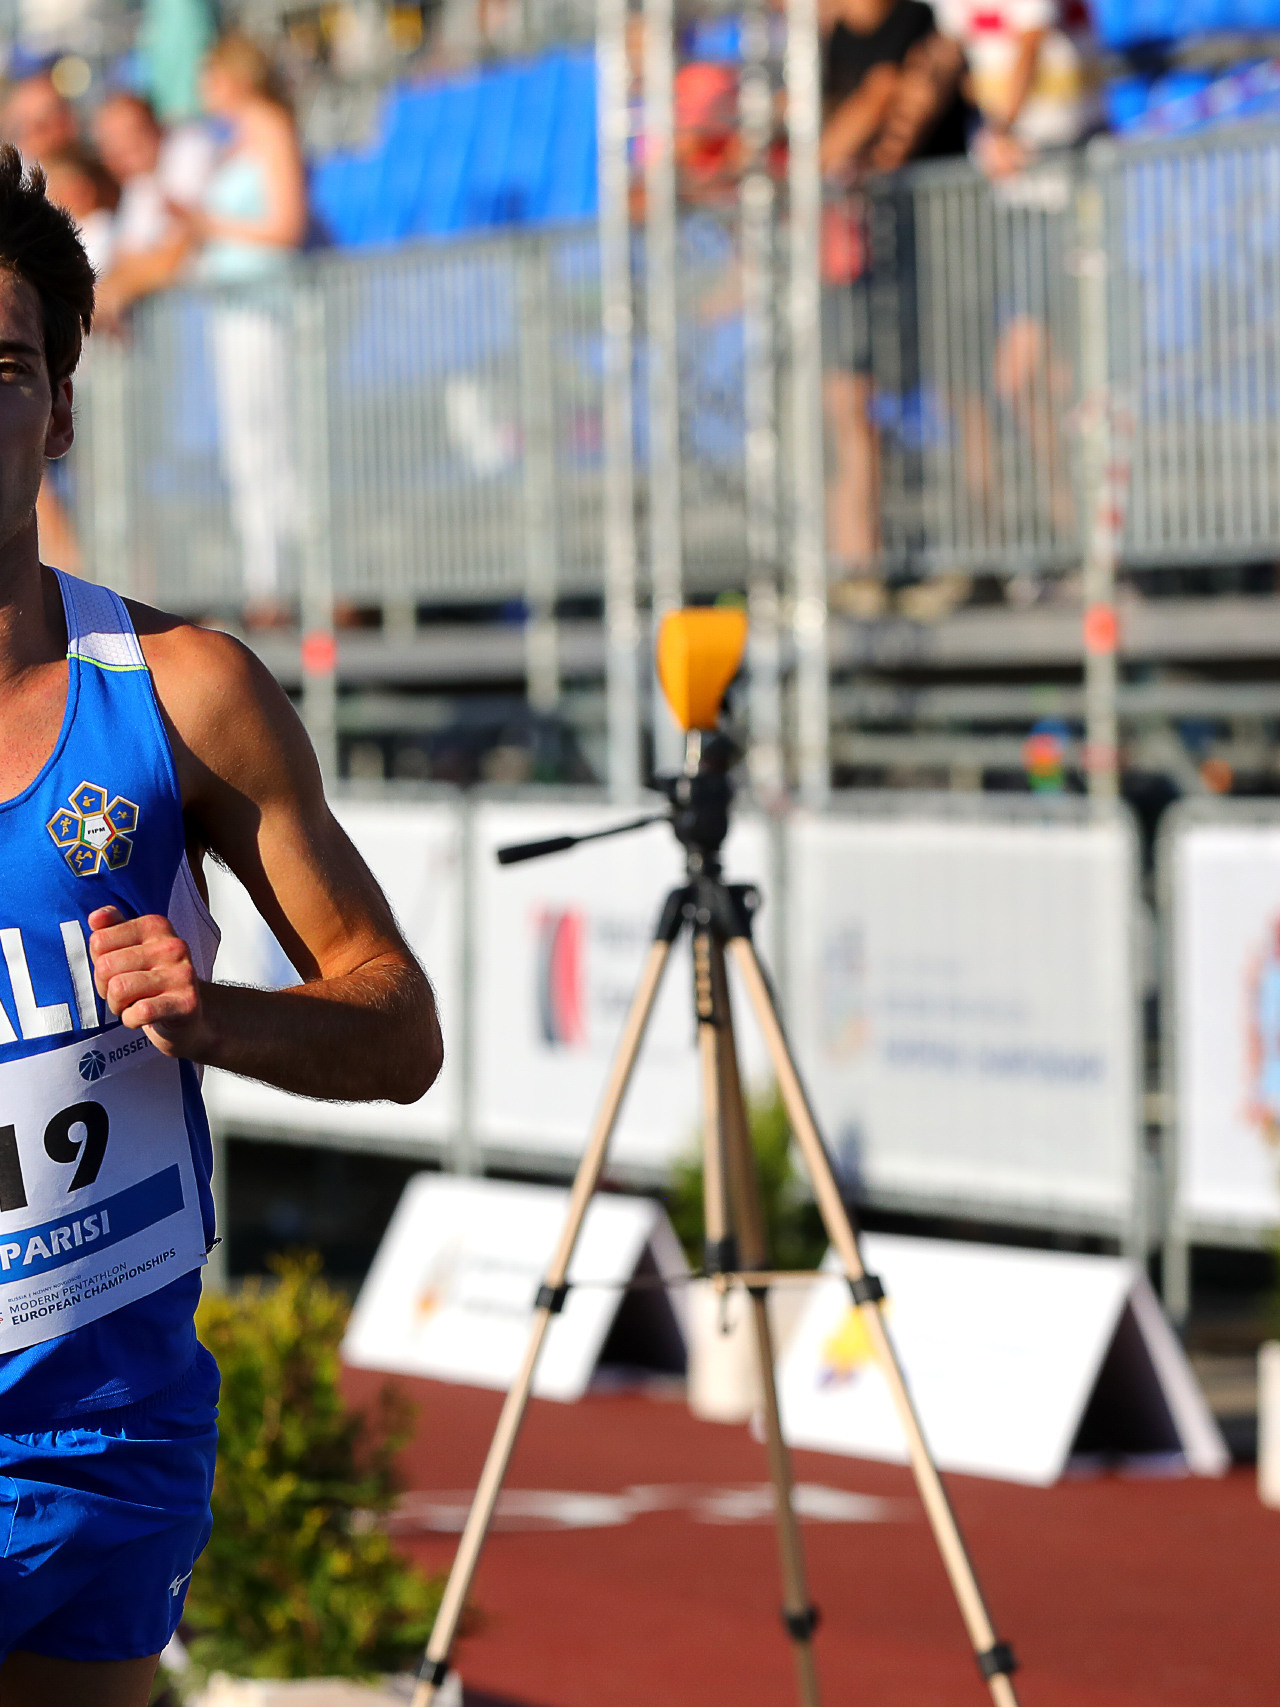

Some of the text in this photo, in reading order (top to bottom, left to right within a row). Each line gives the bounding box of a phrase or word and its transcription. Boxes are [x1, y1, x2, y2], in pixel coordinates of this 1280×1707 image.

[87, 826, 106, 835] FIPM
[9, 1261, 128, 1315] MODERN PENTATHLON
[11, 1247, 177, 1326] EUROPEAN CHAMPIONSHIPS
